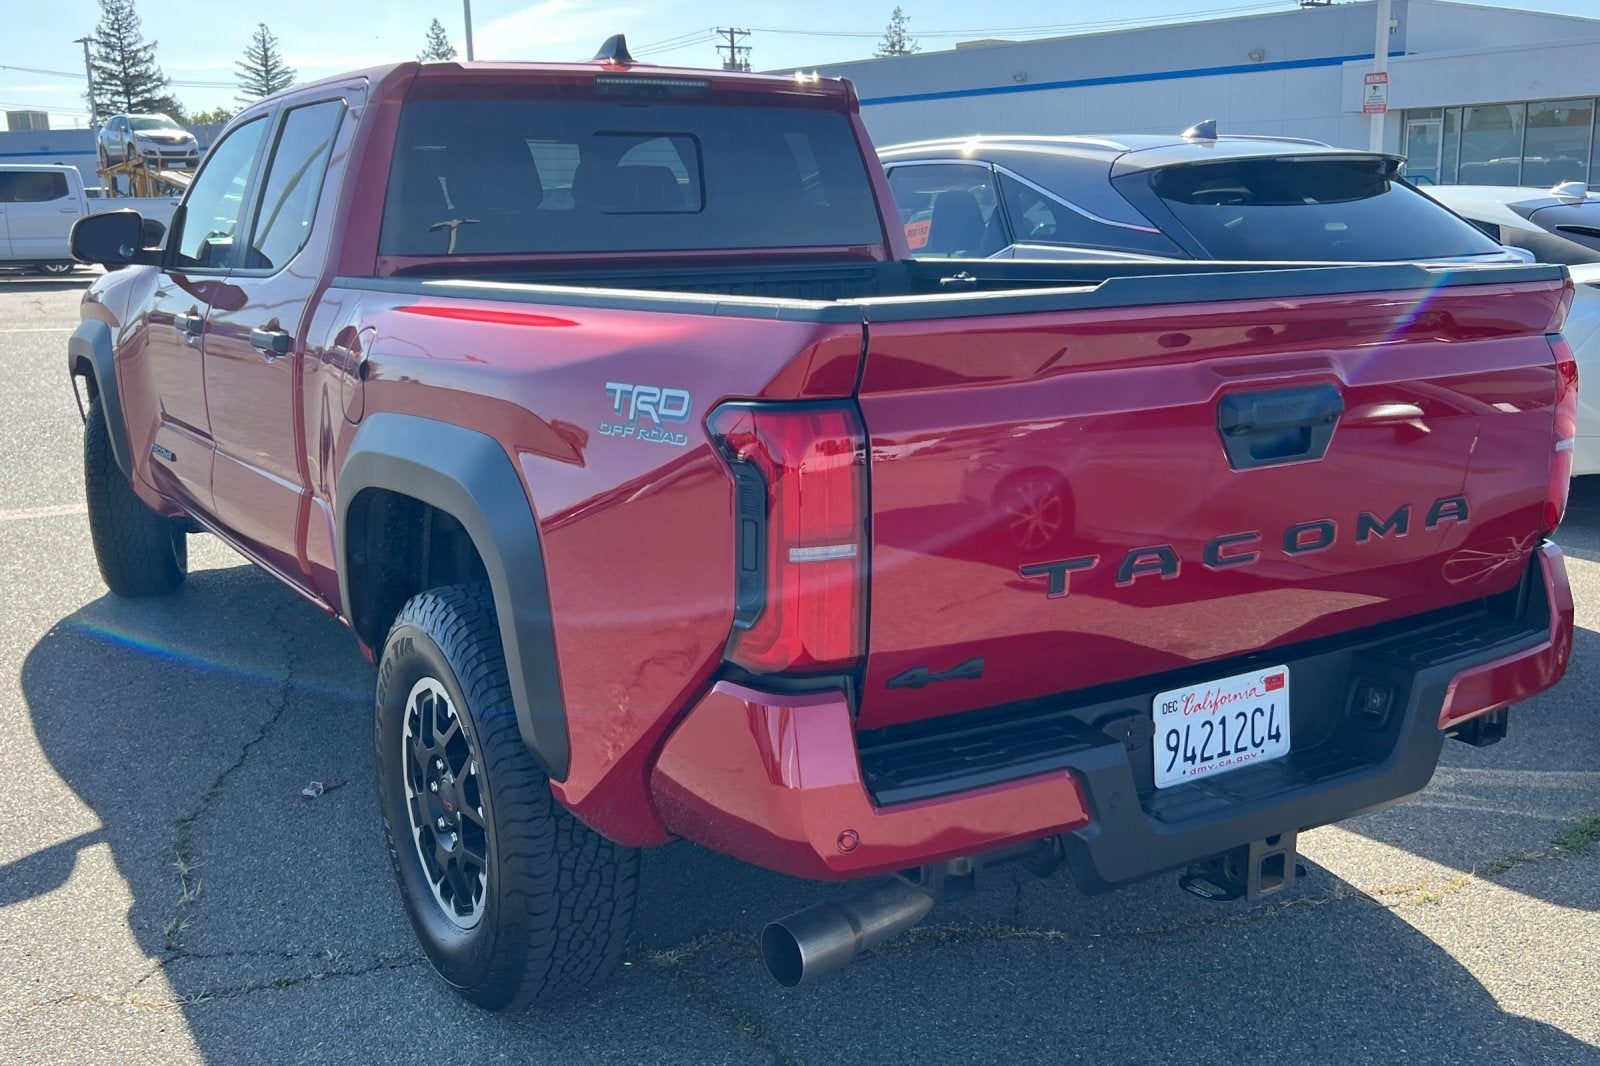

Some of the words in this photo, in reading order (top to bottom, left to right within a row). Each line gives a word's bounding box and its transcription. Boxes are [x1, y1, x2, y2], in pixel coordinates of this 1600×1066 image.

[605, 382, 690, 424] TRD
[598, 421, 634, 438] OFF
[636, 429, 688, 446] ROAD
[1018, 493, 1471, 599] TACOMA
[1162, 700, 1178, 715] DEC
[1184, 686, 1266, 716] California
[1165, 703, 1281, 773] 94212C4
[1190, 752, 1258, 775] dmv.ca.gov
